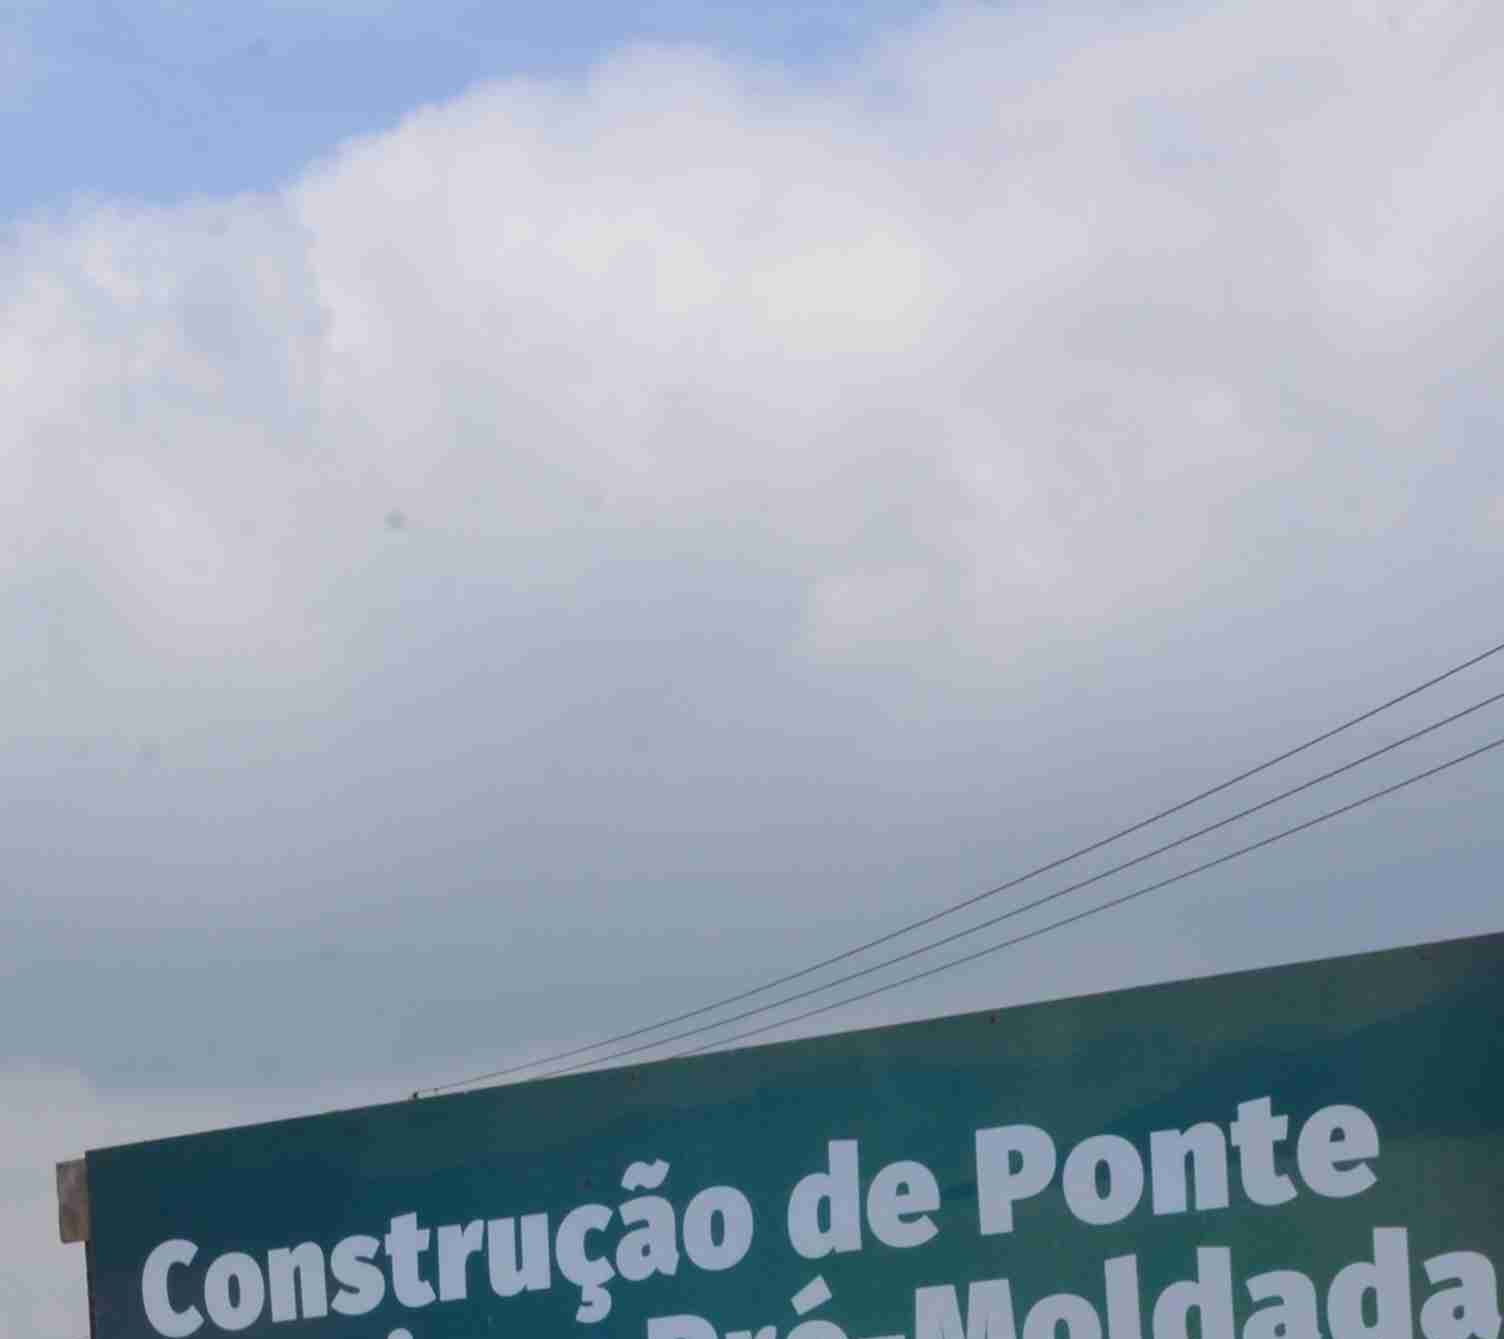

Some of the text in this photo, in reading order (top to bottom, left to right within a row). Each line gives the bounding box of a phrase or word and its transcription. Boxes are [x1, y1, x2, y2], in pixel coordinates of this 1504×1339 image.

[140, 1095, 1381, 1339] Construção de Ponte
